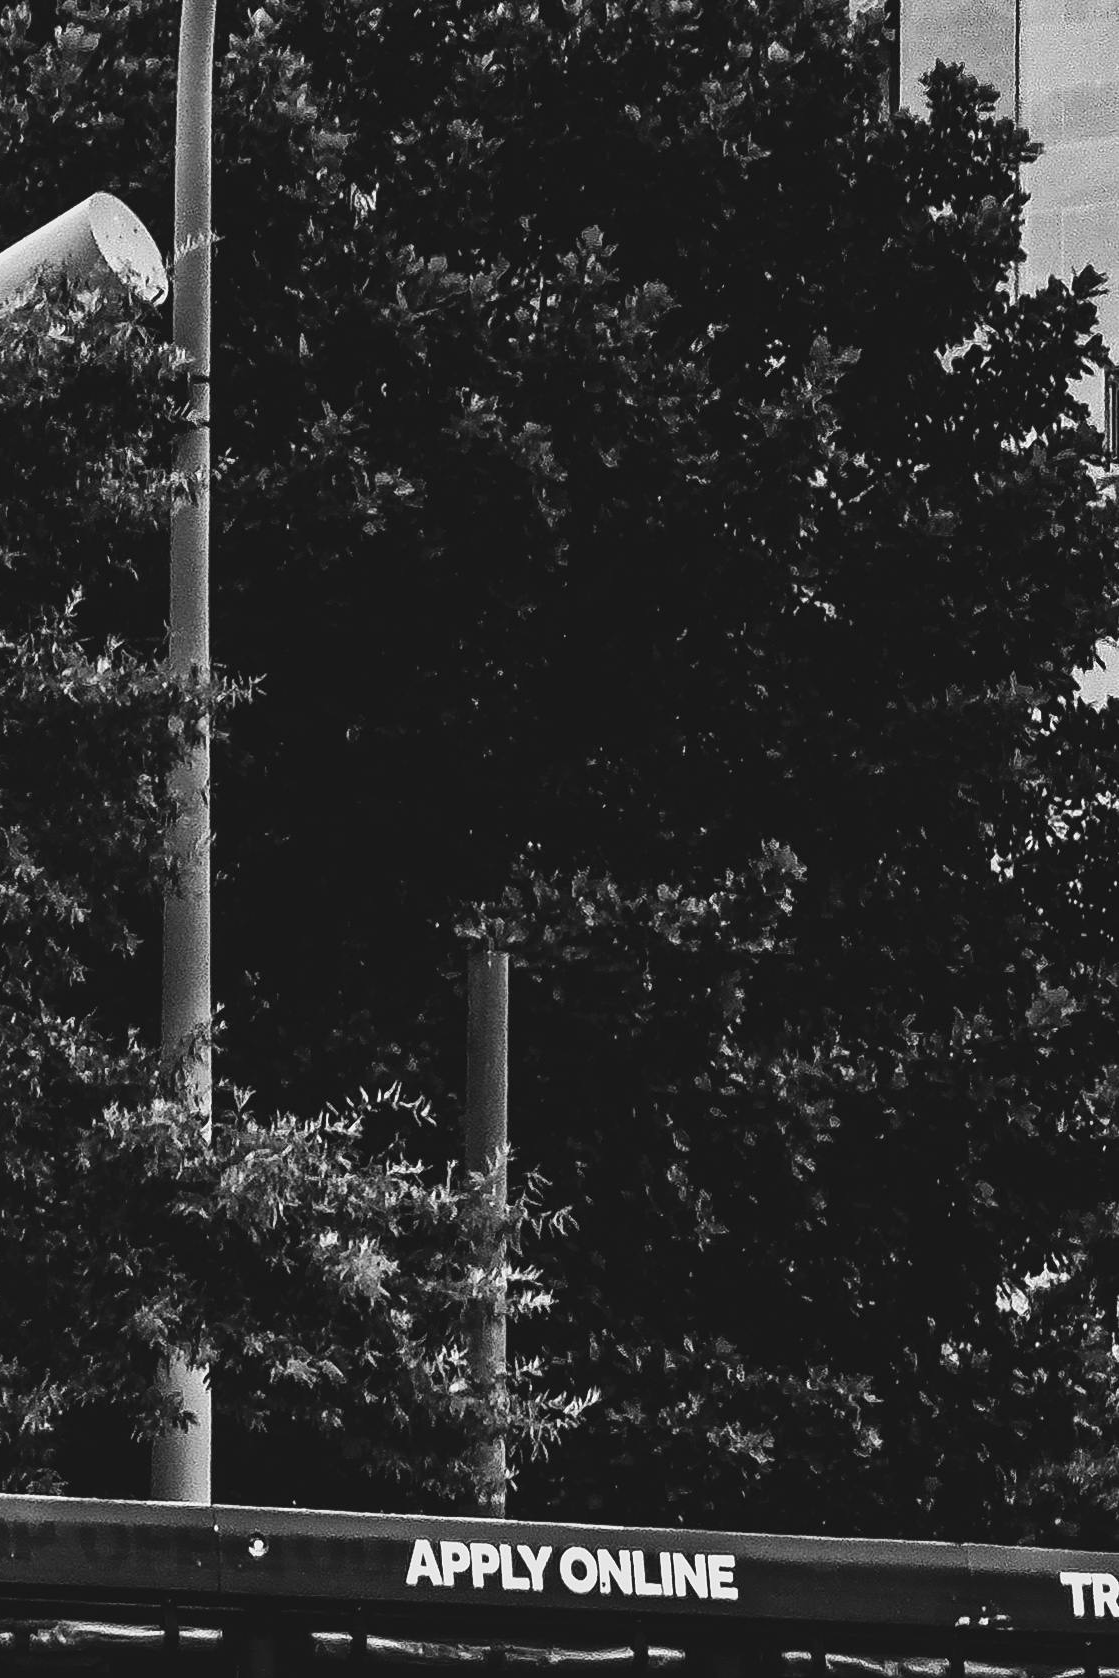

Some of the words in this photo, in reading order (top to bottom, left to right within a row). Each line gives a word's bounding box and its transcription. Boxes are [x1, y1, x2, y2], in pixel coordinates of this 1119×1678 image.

[405, 1538, 554, 1592] APPLY
[558, 1545, 740, 1601] ONLINE
[1058, 1570, 1119, 1619] TR
